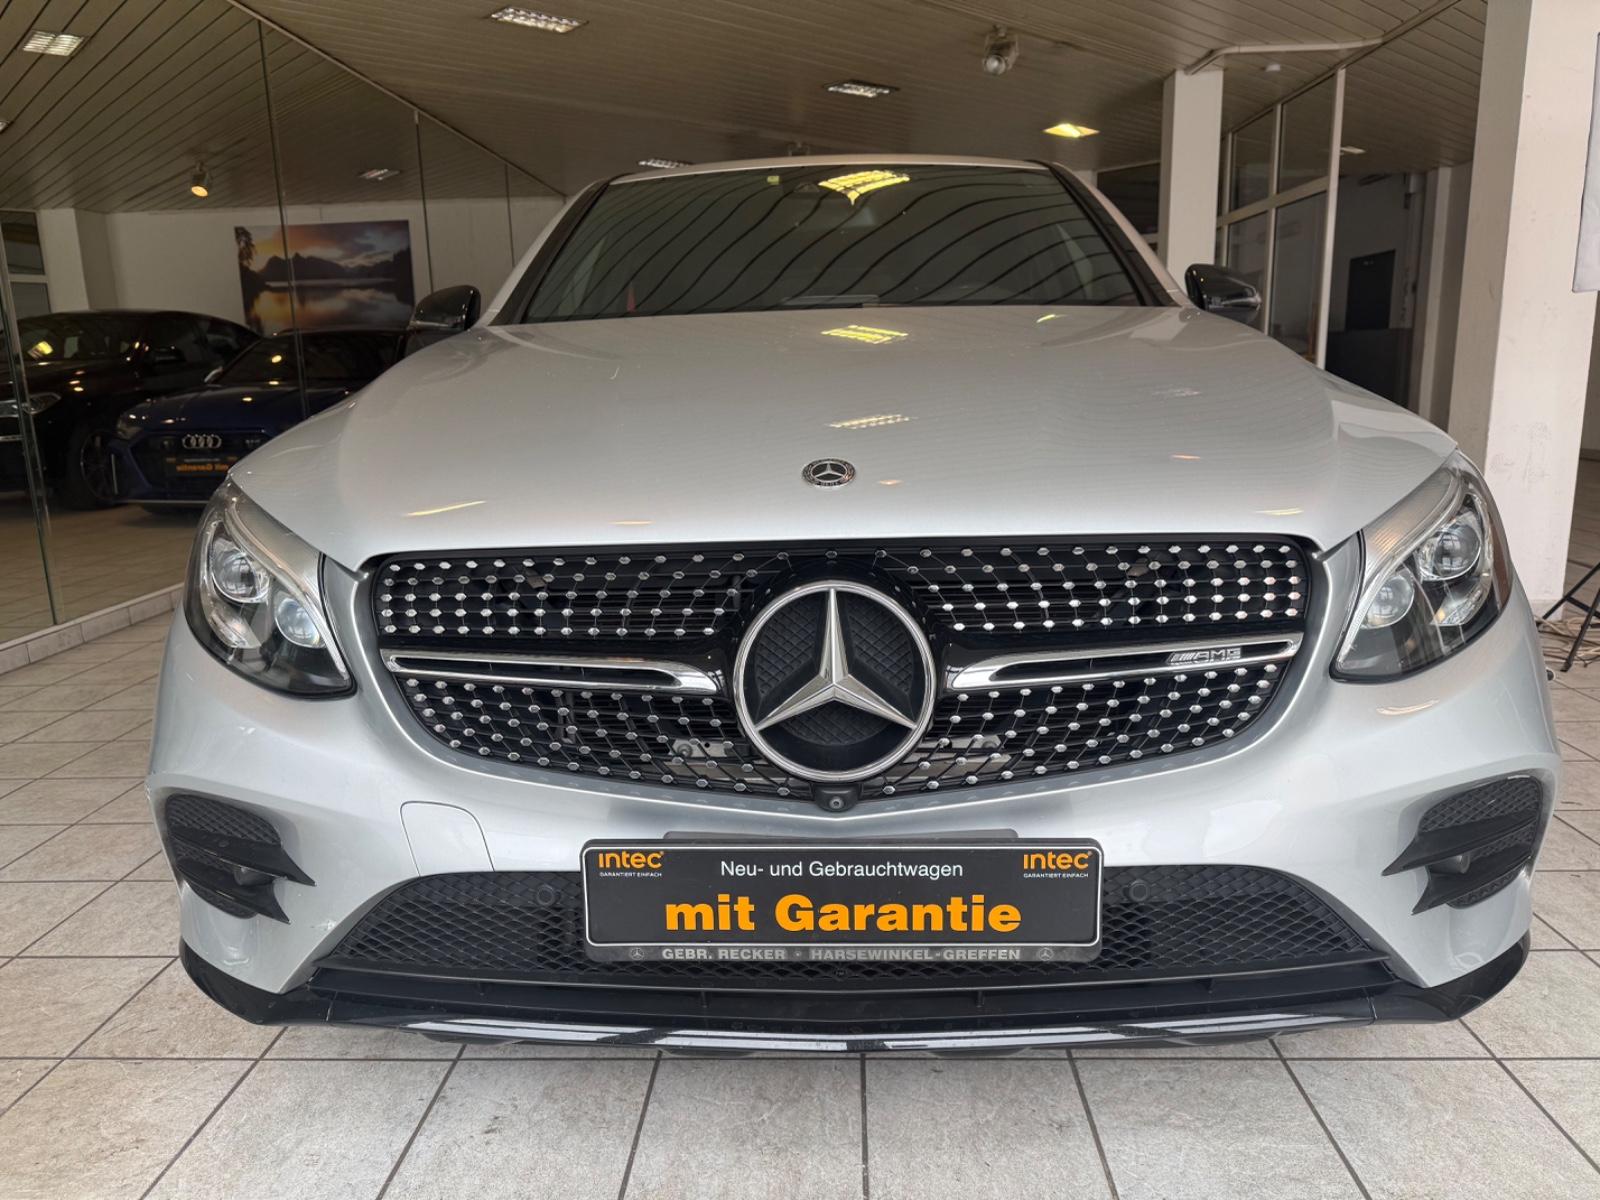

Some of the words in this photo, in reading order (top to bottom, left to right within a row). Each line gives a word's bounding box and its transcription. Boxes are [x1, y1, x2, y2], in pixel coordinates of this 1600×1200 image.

[1194, 647, 1242, 662] AMG
[598, 851, 663, 869] intec
[1023, 851, 1090, 870] intec
[721, 861, 764, 877] Neu-
[770, 861, 803, 877] und
[809, 861, 963, 881] Gebrauchtwagen
[665, 893, 755, 931] mit
[775, 893, 1022, 932] Garantie
[662, 948, 713, 960] GEBR.
[718, 948, 786, 960] RECKER
[810, 948, 1021, 960] HARSEWINKEL-GREFFEN
